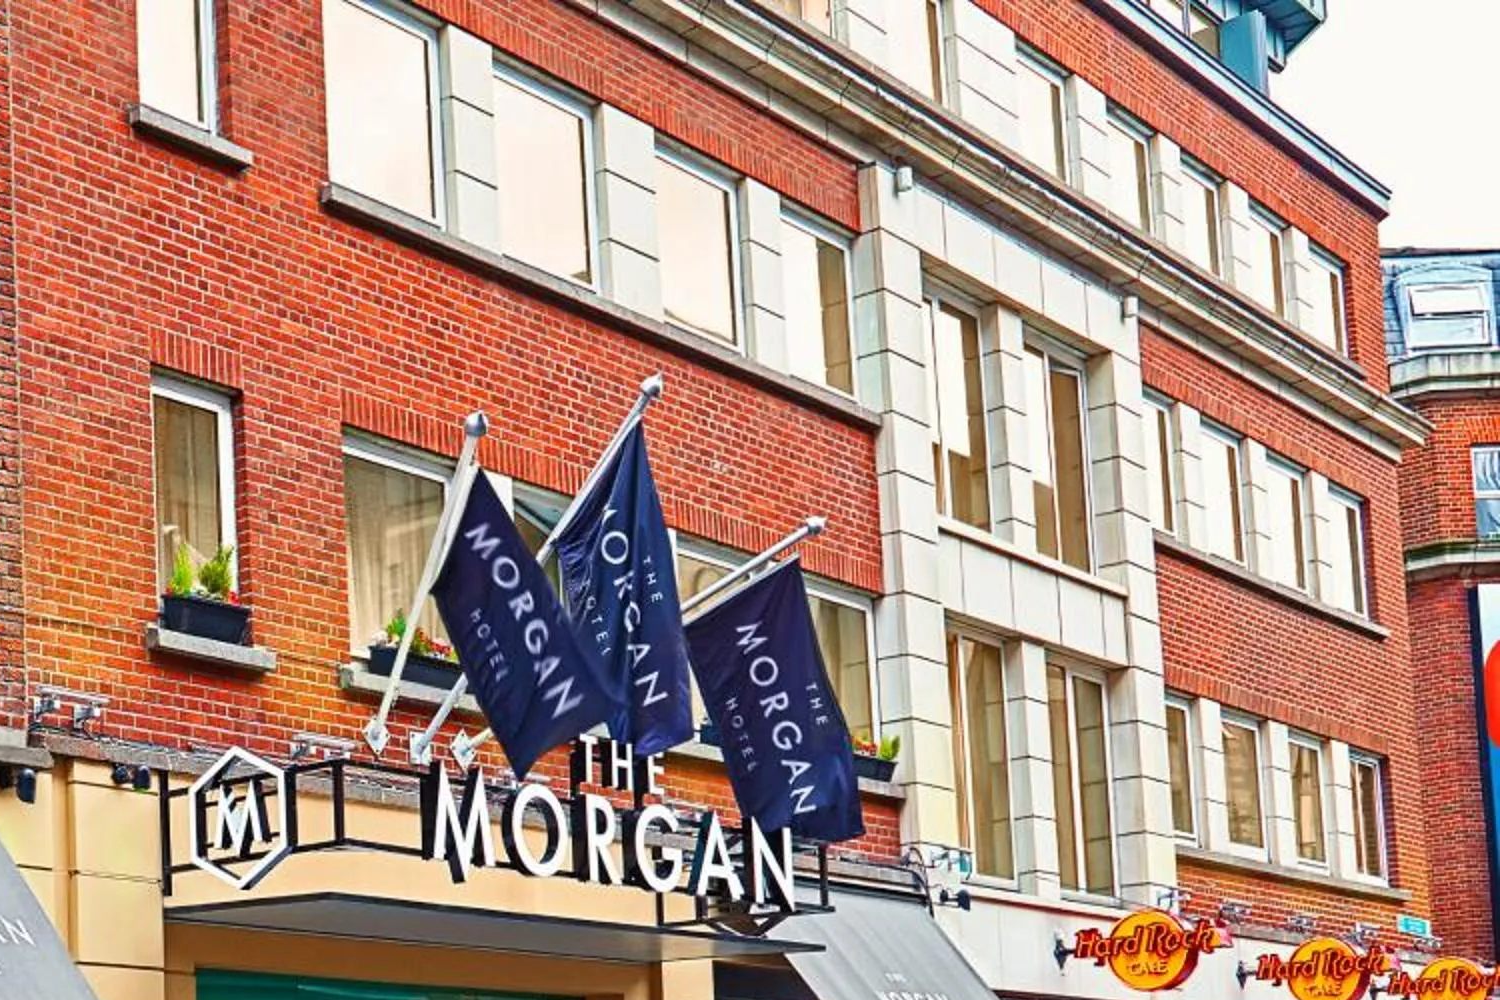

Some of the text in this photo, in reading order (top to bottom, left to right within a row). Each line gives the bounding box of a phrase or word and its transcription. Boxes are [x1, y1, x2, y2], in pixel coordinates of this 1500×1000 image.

[643, 556, 664, 603] THE
[464, 522, 585, 720] MORGAN
[736, 620, 817, 815] MORGAN
[806, 682, 829, 726] THE
[725, 696, 758, 772] HOTEL
[579, 733, 665, 796] THE
[433, 759, 795, 913] MORGAN
[1074, 919, 1215, 962] Hard Rock
[1256, 945, 1385, 983] Hard Rock
[1388, 969, 1449, 999] Hard
